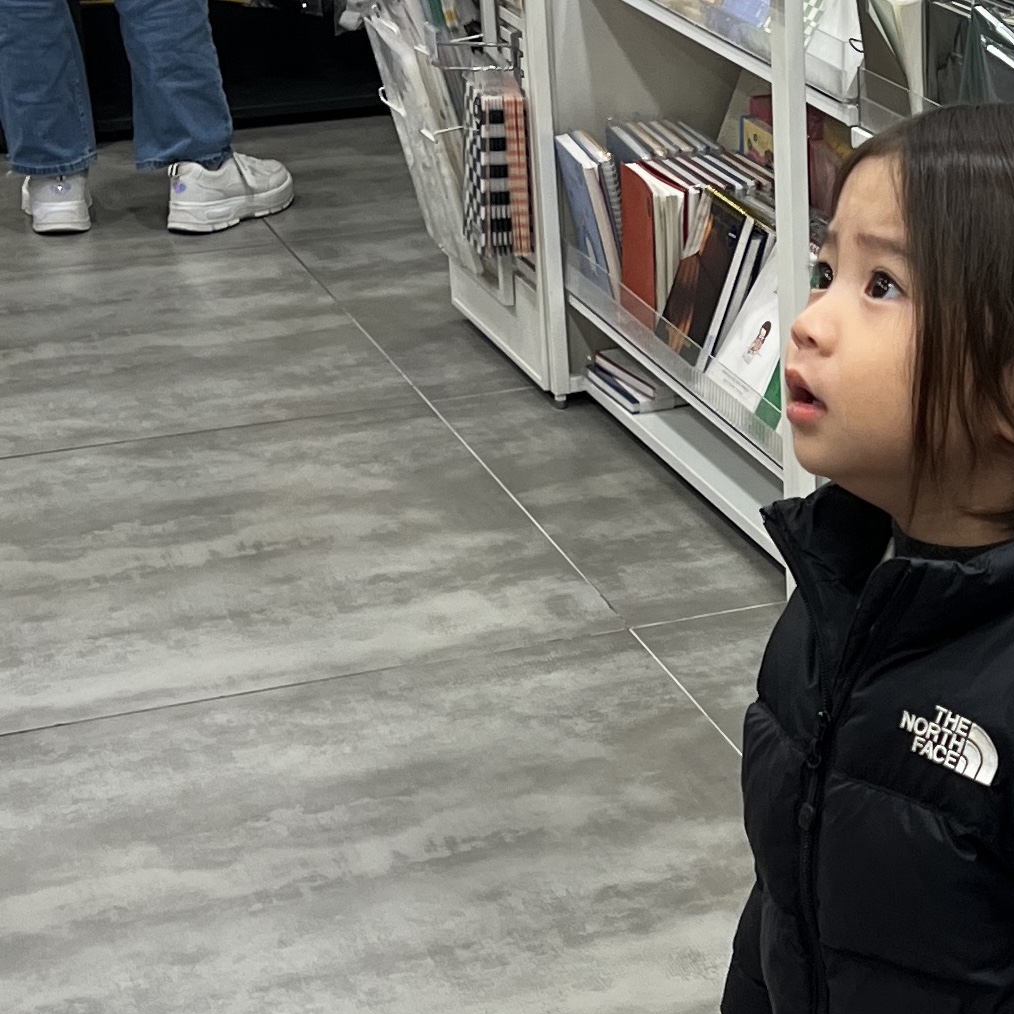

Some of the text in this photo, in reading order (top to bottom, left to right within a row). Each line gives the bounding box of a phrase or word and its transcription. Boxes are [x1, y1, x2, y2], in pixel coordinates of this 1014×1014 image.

[899, 709, 966, 755] NORTH
[935, 704, 972, 738] THE
[911, 735, 961, 770] FACE
